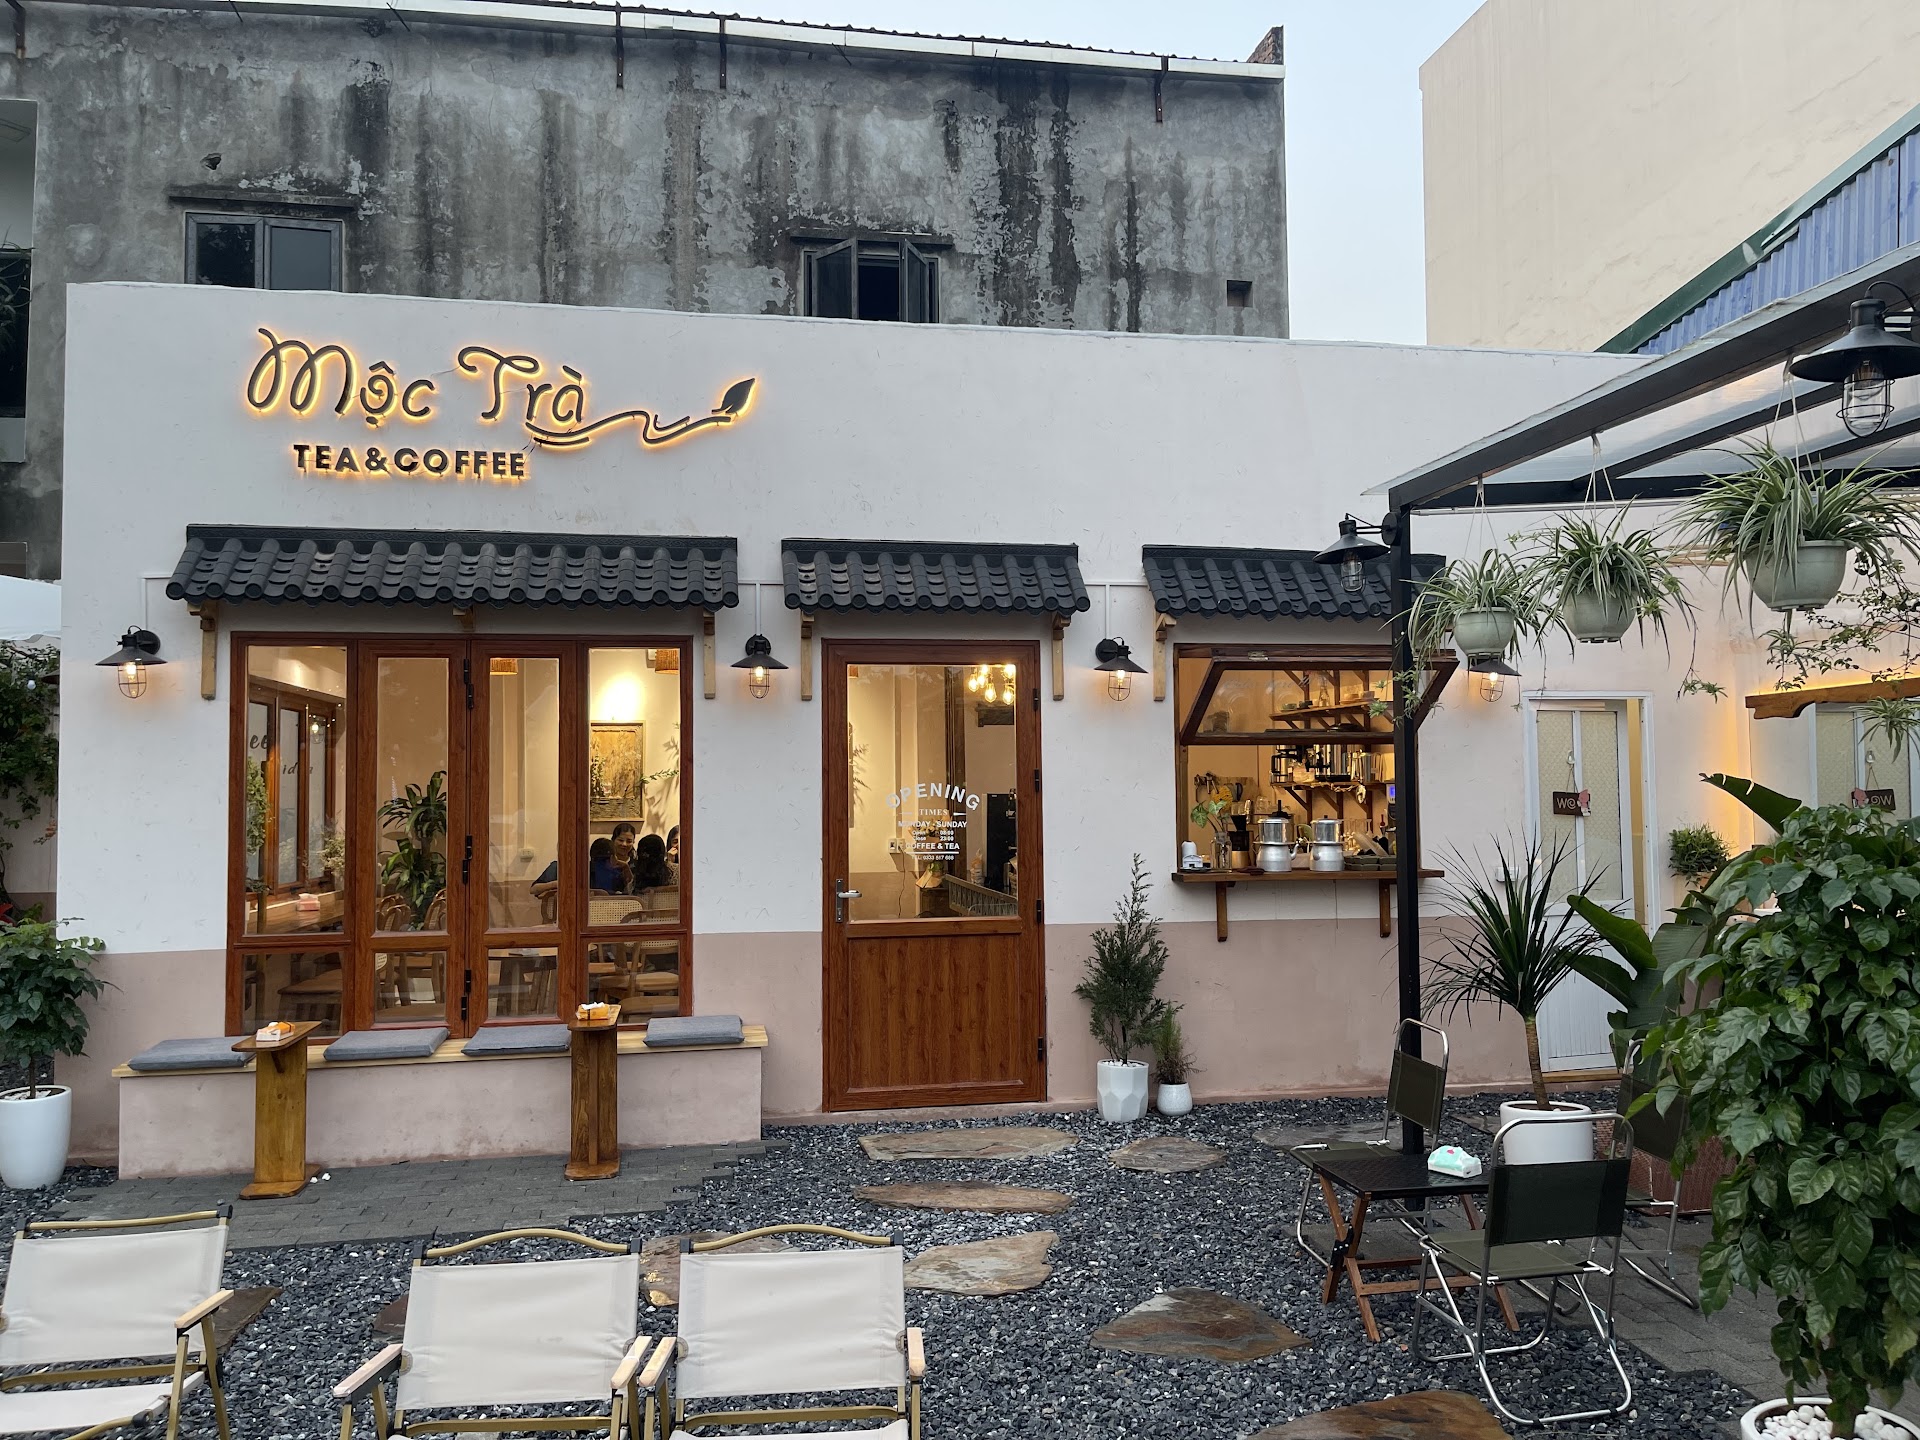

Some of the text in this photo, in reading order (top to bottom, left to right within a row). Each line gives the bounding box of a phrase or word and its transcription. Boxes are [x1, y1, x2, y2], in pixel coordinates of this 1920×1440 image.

[247, 327, 584, 425] Mộc Trà
[293, 444, 525, 477] TEA&COFFEE
[885, 782, 981, 811] OPENING
[919, 808, 949, 816] TIMES
[936, 820, 968, 828] SUNDAY
[937, 842, 943, 850] &
[944, 842, 960, 850] TEA
